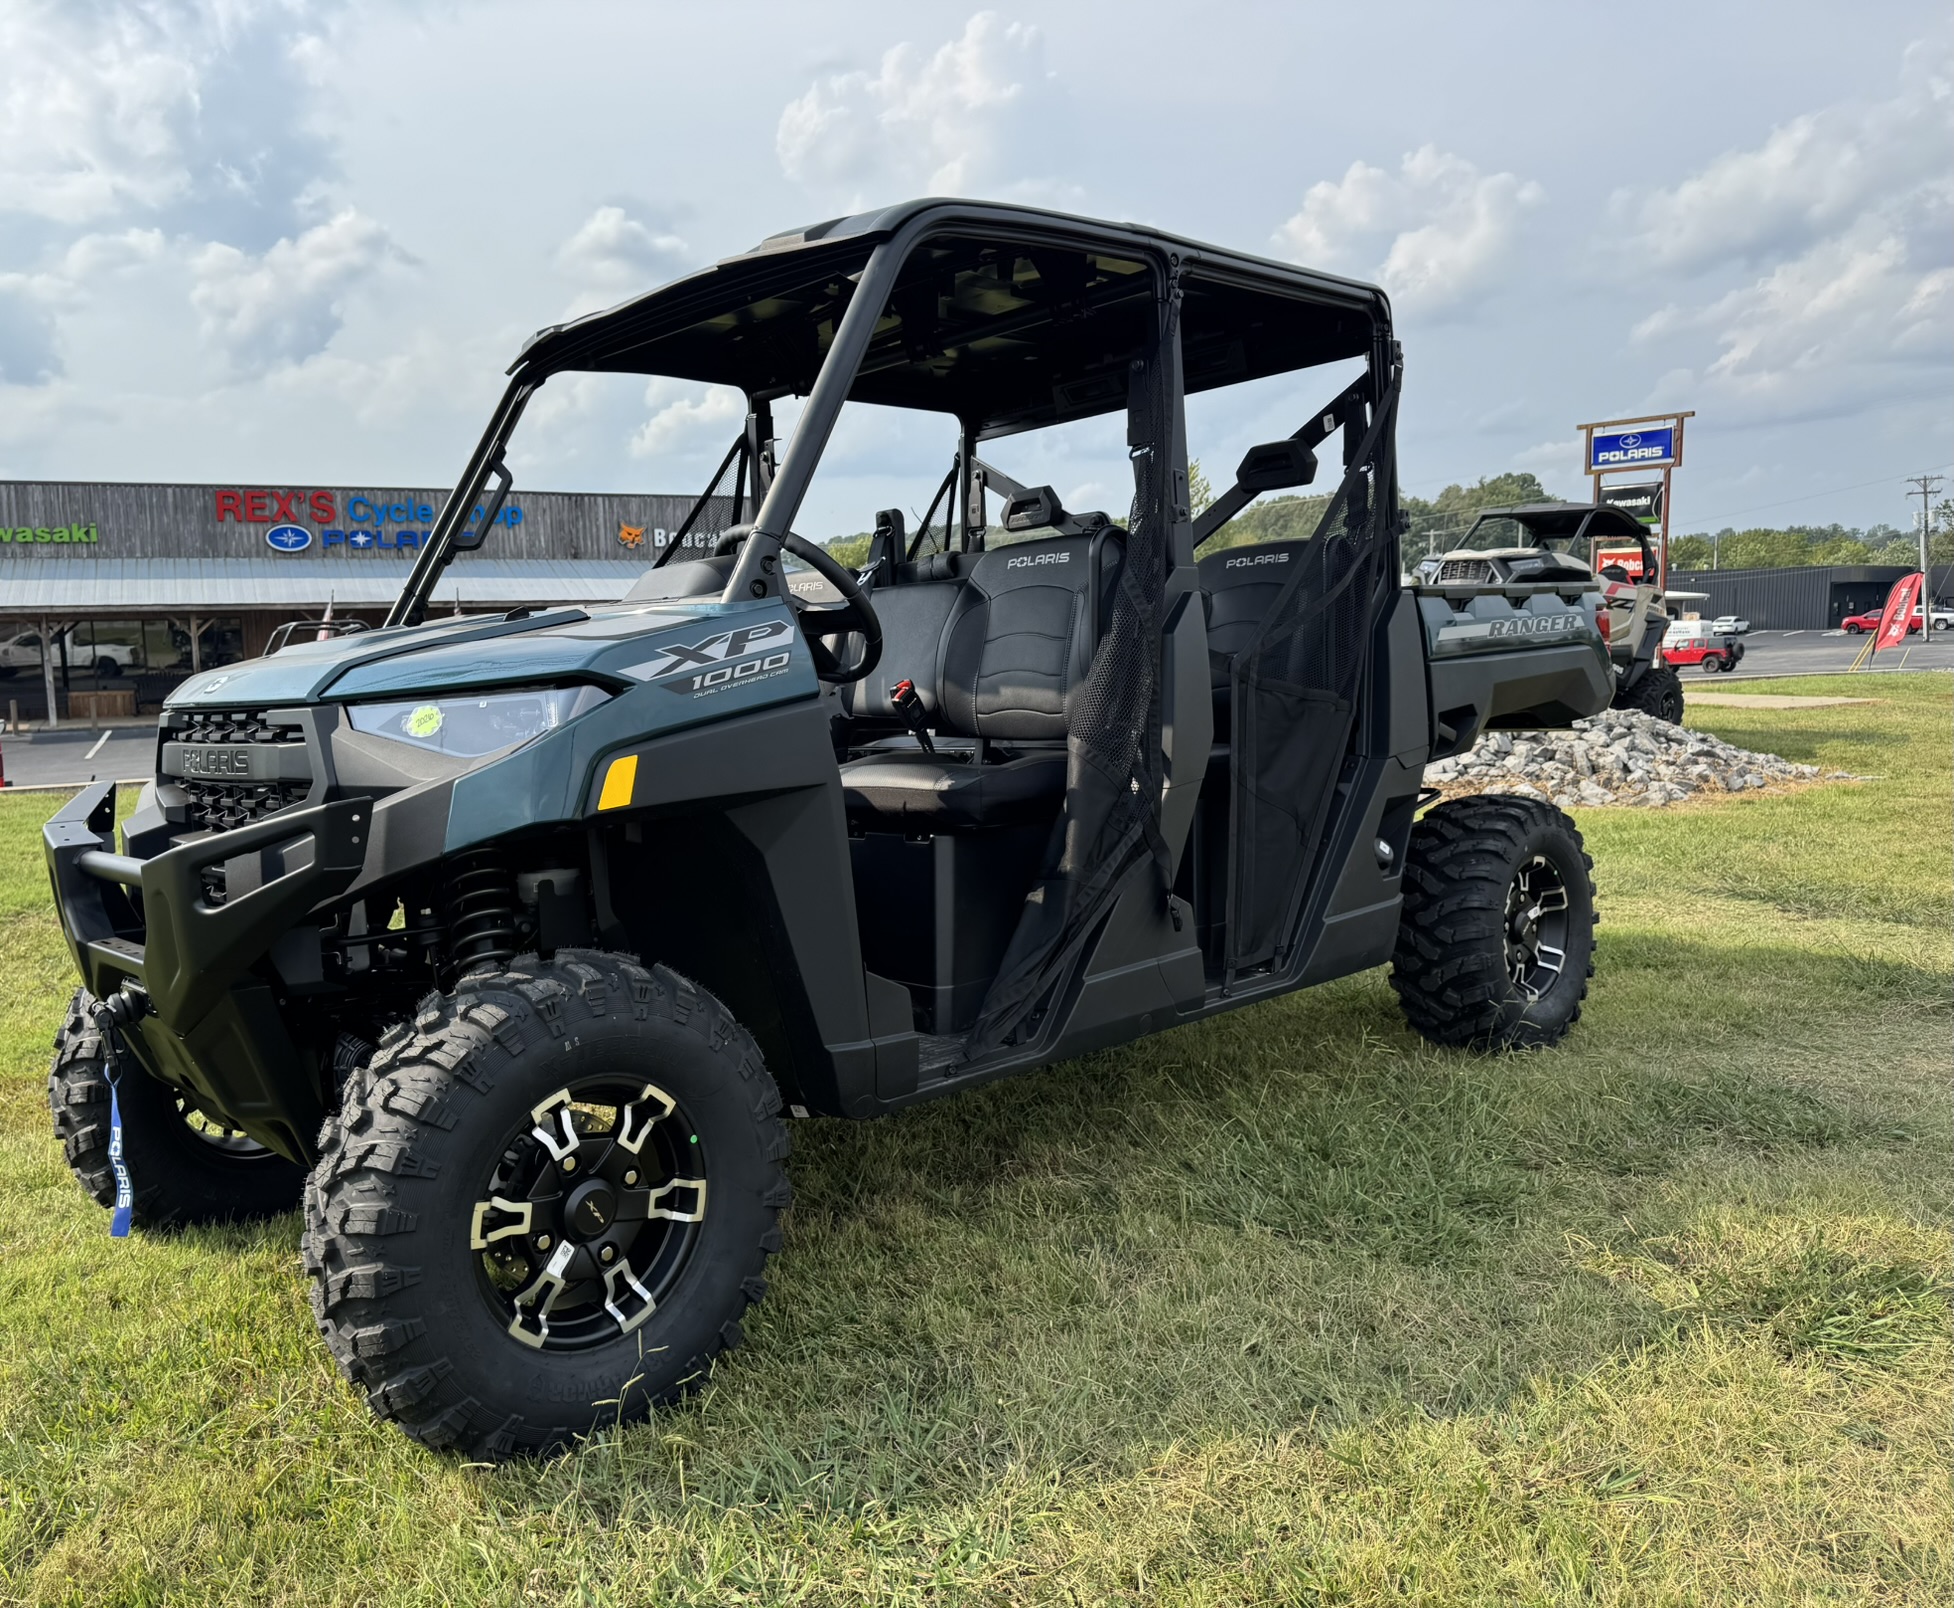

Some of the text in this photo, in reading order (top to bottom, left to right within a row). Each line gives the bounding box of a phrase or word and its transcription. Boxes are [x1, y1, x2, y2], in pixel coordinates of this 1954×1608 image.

[1598, 446, 1664, 463] POLARIS
[348, 497, 434, 527] Cycle
[469, 504, 523, 529] hop
[0, 522, 99, 543] wasaki
[1007, 552, 1070, 570] POLARIS
[1226, 553, 1290, 569] POLARIS
[1617, 559, 1644, 571] Bobc
[788, 581, 824, 593] OLARIS
[1486, 613, 1578, 639] RANGER
[650, 620, 791, 678] XP
[692, 652, 790, 690] 1000
[693, 668, 789, 699] DUAL OVERHEAD CAM
[183, 749, 249, 775] POLARIS
[108, 1125, 131, 1209] POLARIS
[585, 1200, 605, 1224] XP
